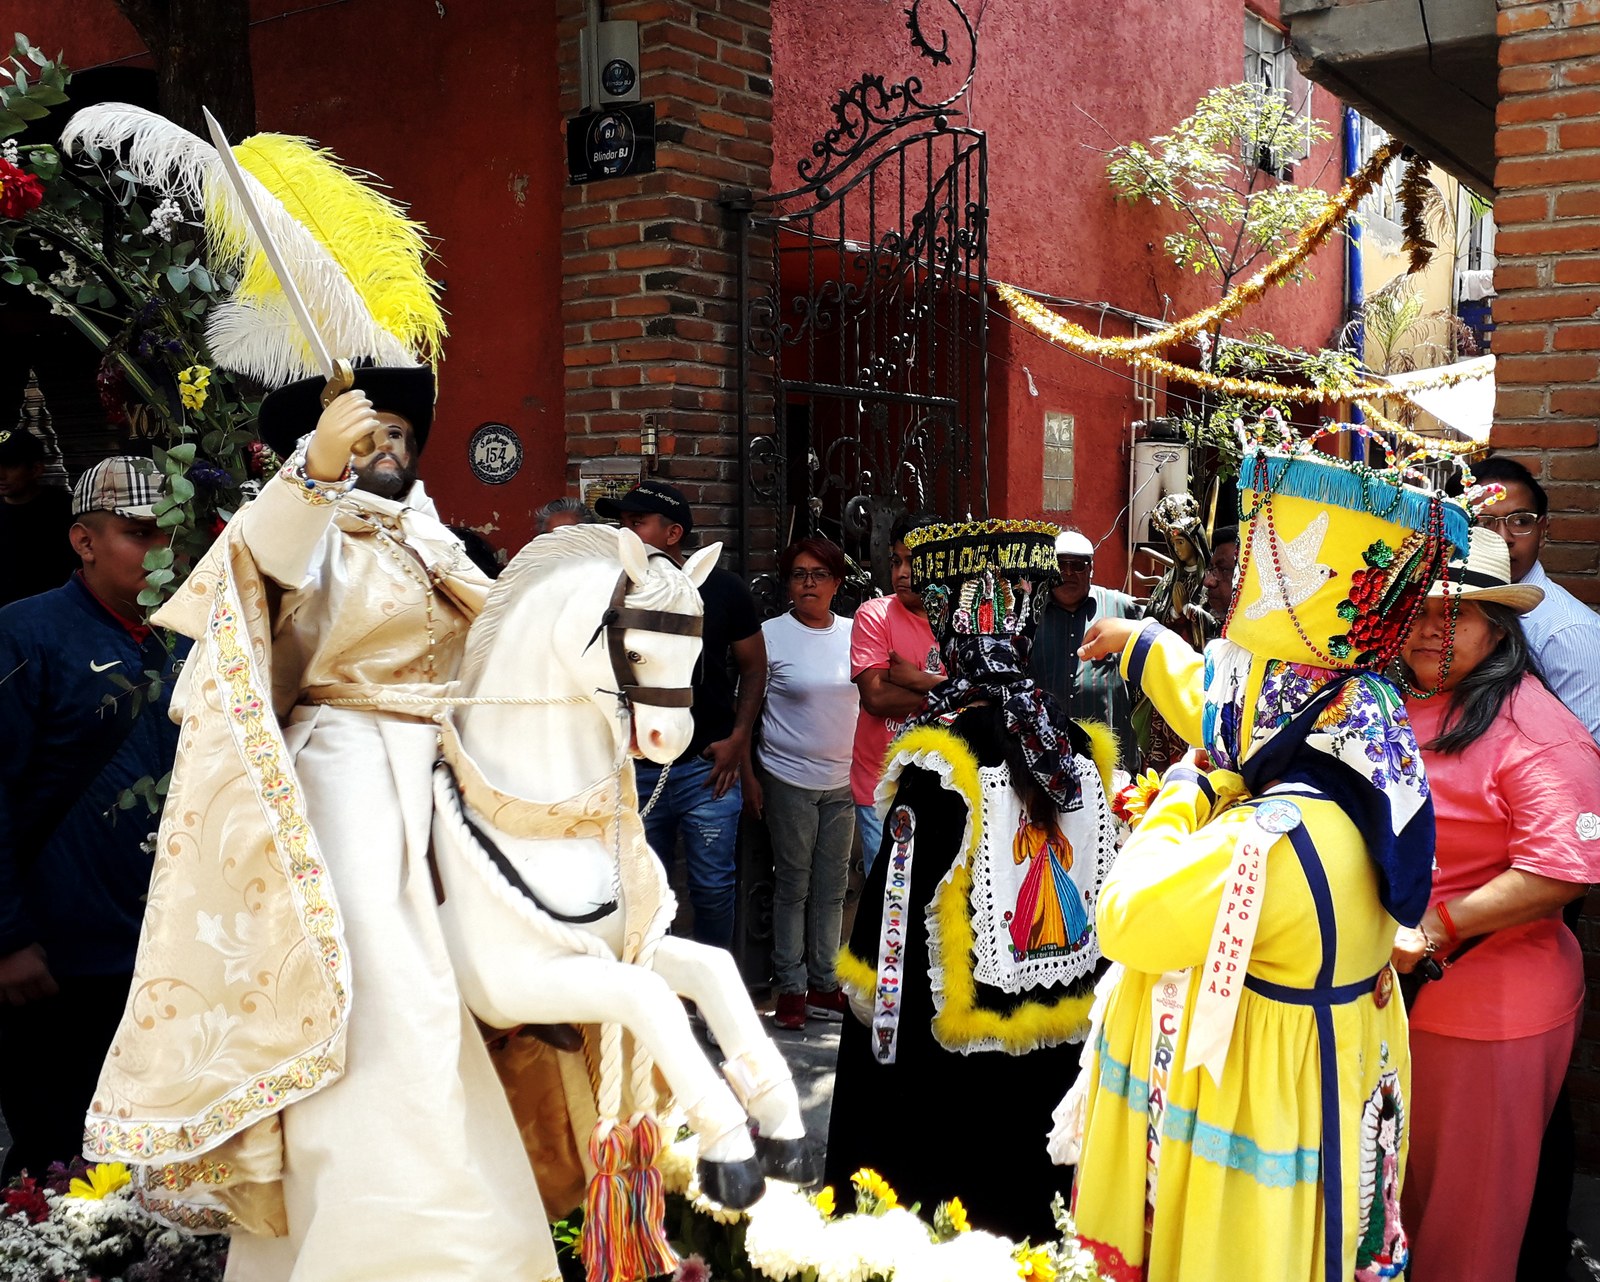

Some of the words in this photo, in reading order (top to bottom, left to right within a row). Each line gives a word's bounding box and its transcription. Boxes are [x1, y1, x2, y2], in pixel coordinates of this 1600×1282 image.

[593, 149, 618, 162] Blindar
[618, 147, 629, 158] BJ
[605, 129, 615, 139] BJ
[486, 447, 507, 463] 154
[948, 544, 989, 576] LOS
[1238, 847, 1260, 921] AJUSCO
[1208, 844, 1251, 994] COMPARSA
[1220, 936, 1244, 998] MEDIO
[1146, 1013, 1177, 1165] CARNAVAL
